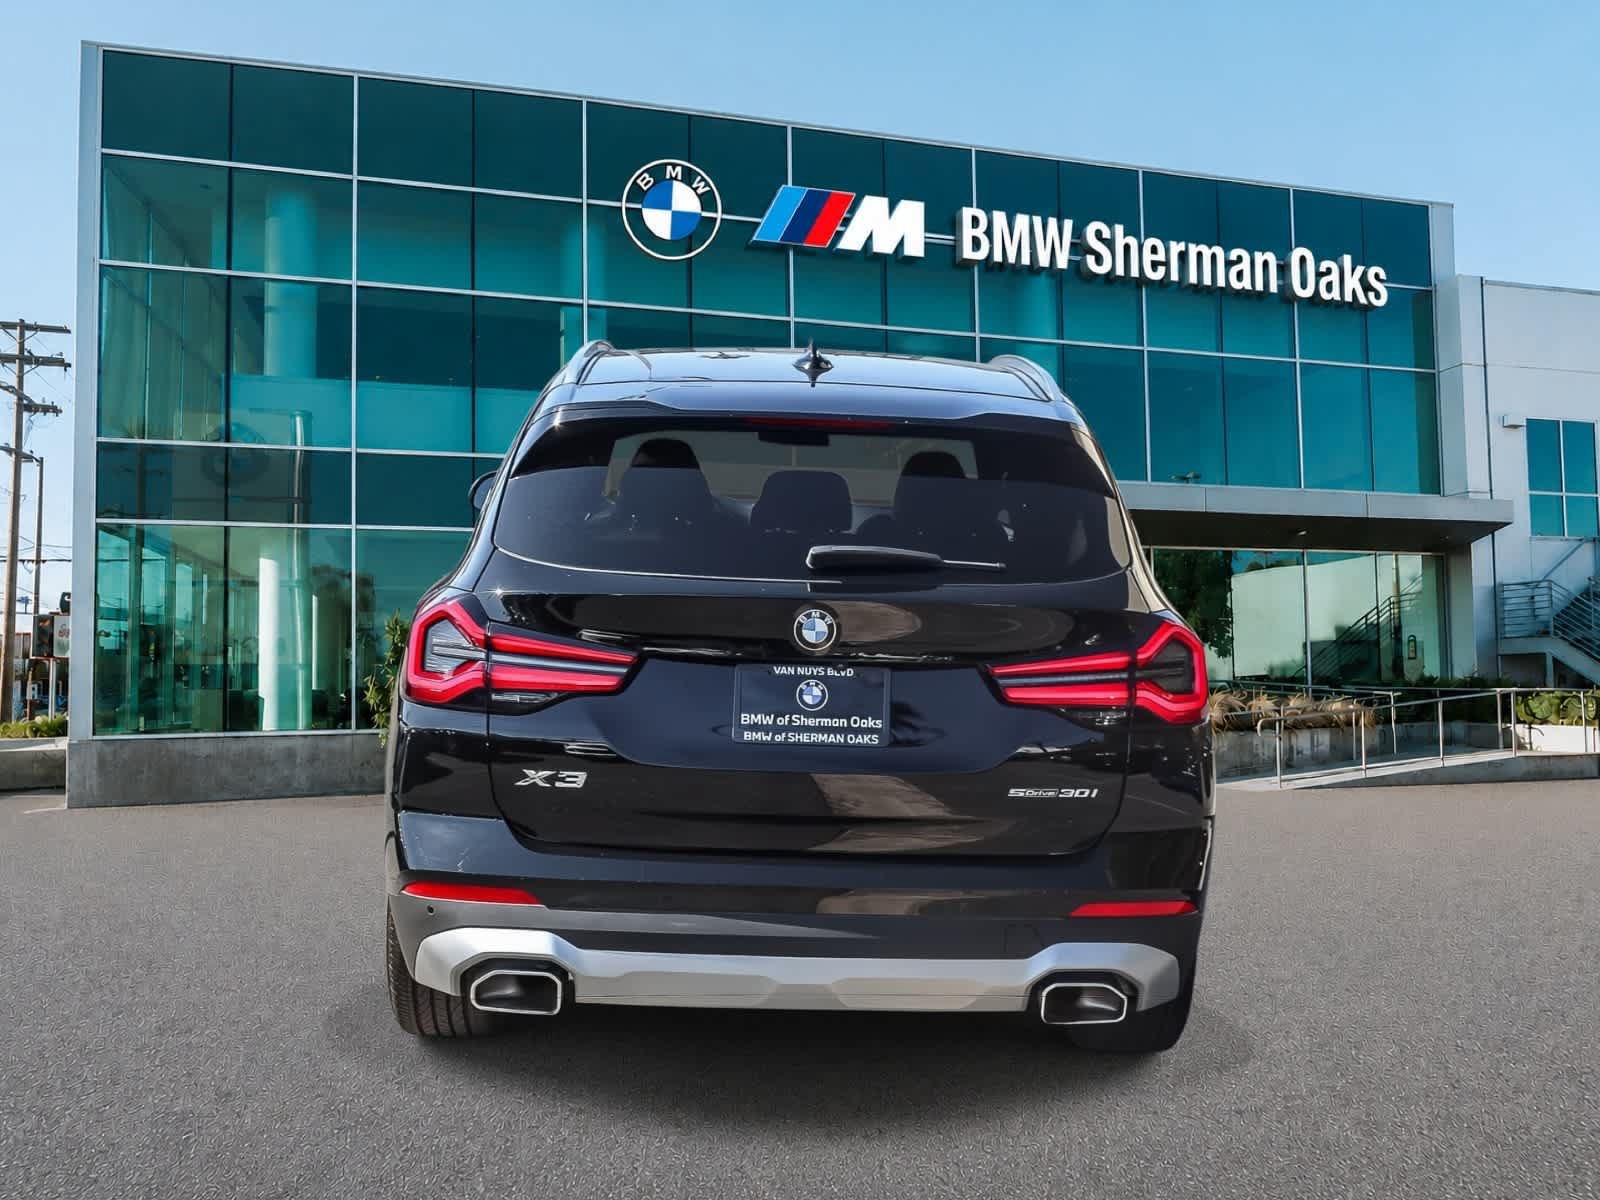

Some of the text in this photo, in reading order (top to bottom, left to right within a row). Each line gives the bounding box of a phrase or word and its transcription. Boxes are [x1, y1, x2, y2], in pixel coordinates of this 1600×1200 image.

[636, 165, 711, 195] BMW
[960, 206, 1388, 307] BMW Sherman Oaks
[773, 666, 795, 676] VAN
[797, 667, 825, 677] NUYS
[740, 713, 883, 729] BMW of Sherman Oaks
[743, 731, 879, 744] BMW of SHERMAN OAKS
[514, 769, 588, 788] X3
